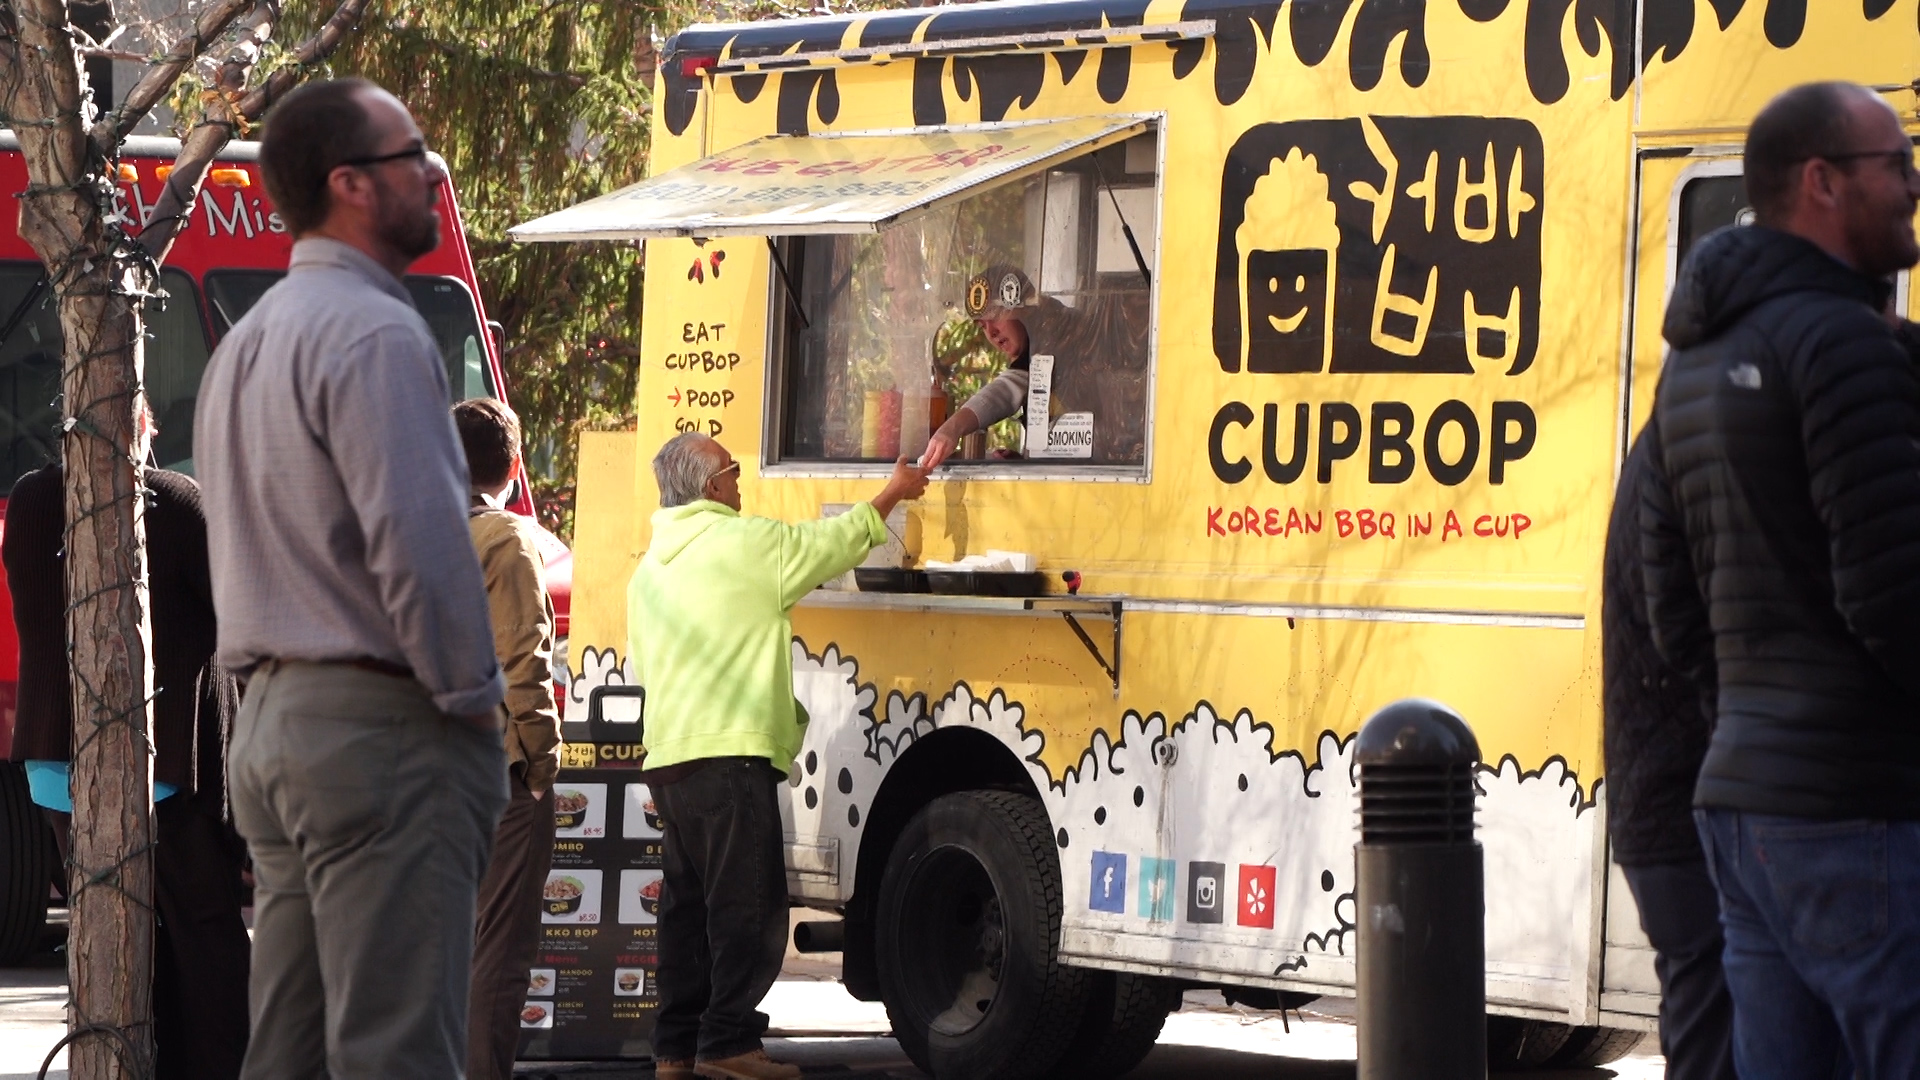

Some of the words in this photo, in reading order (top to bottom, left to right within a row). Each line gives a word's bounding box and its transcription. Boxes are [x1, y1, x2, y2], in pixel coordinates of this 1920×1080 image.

[201, 188, 286, 239] Mis
[682, 321, 726, 345] EAT
[665, 350, 741, 374] CUPBOP
[686, 388, 735, 408] POOP
[1047, 430, 1092, 446] SMOKING
[1208, 399, 1537, 486] CUPBOP
[1206, 505, 1322, 539] KOREAN
[1334, 508, 1395, 540] BBQ
[1407, 512, 1431, 538] IN
[1441, 509, 1463, 542] A
[1473, 513, 1532, 539] CUP
[600, 745, 648, 760] CUP
